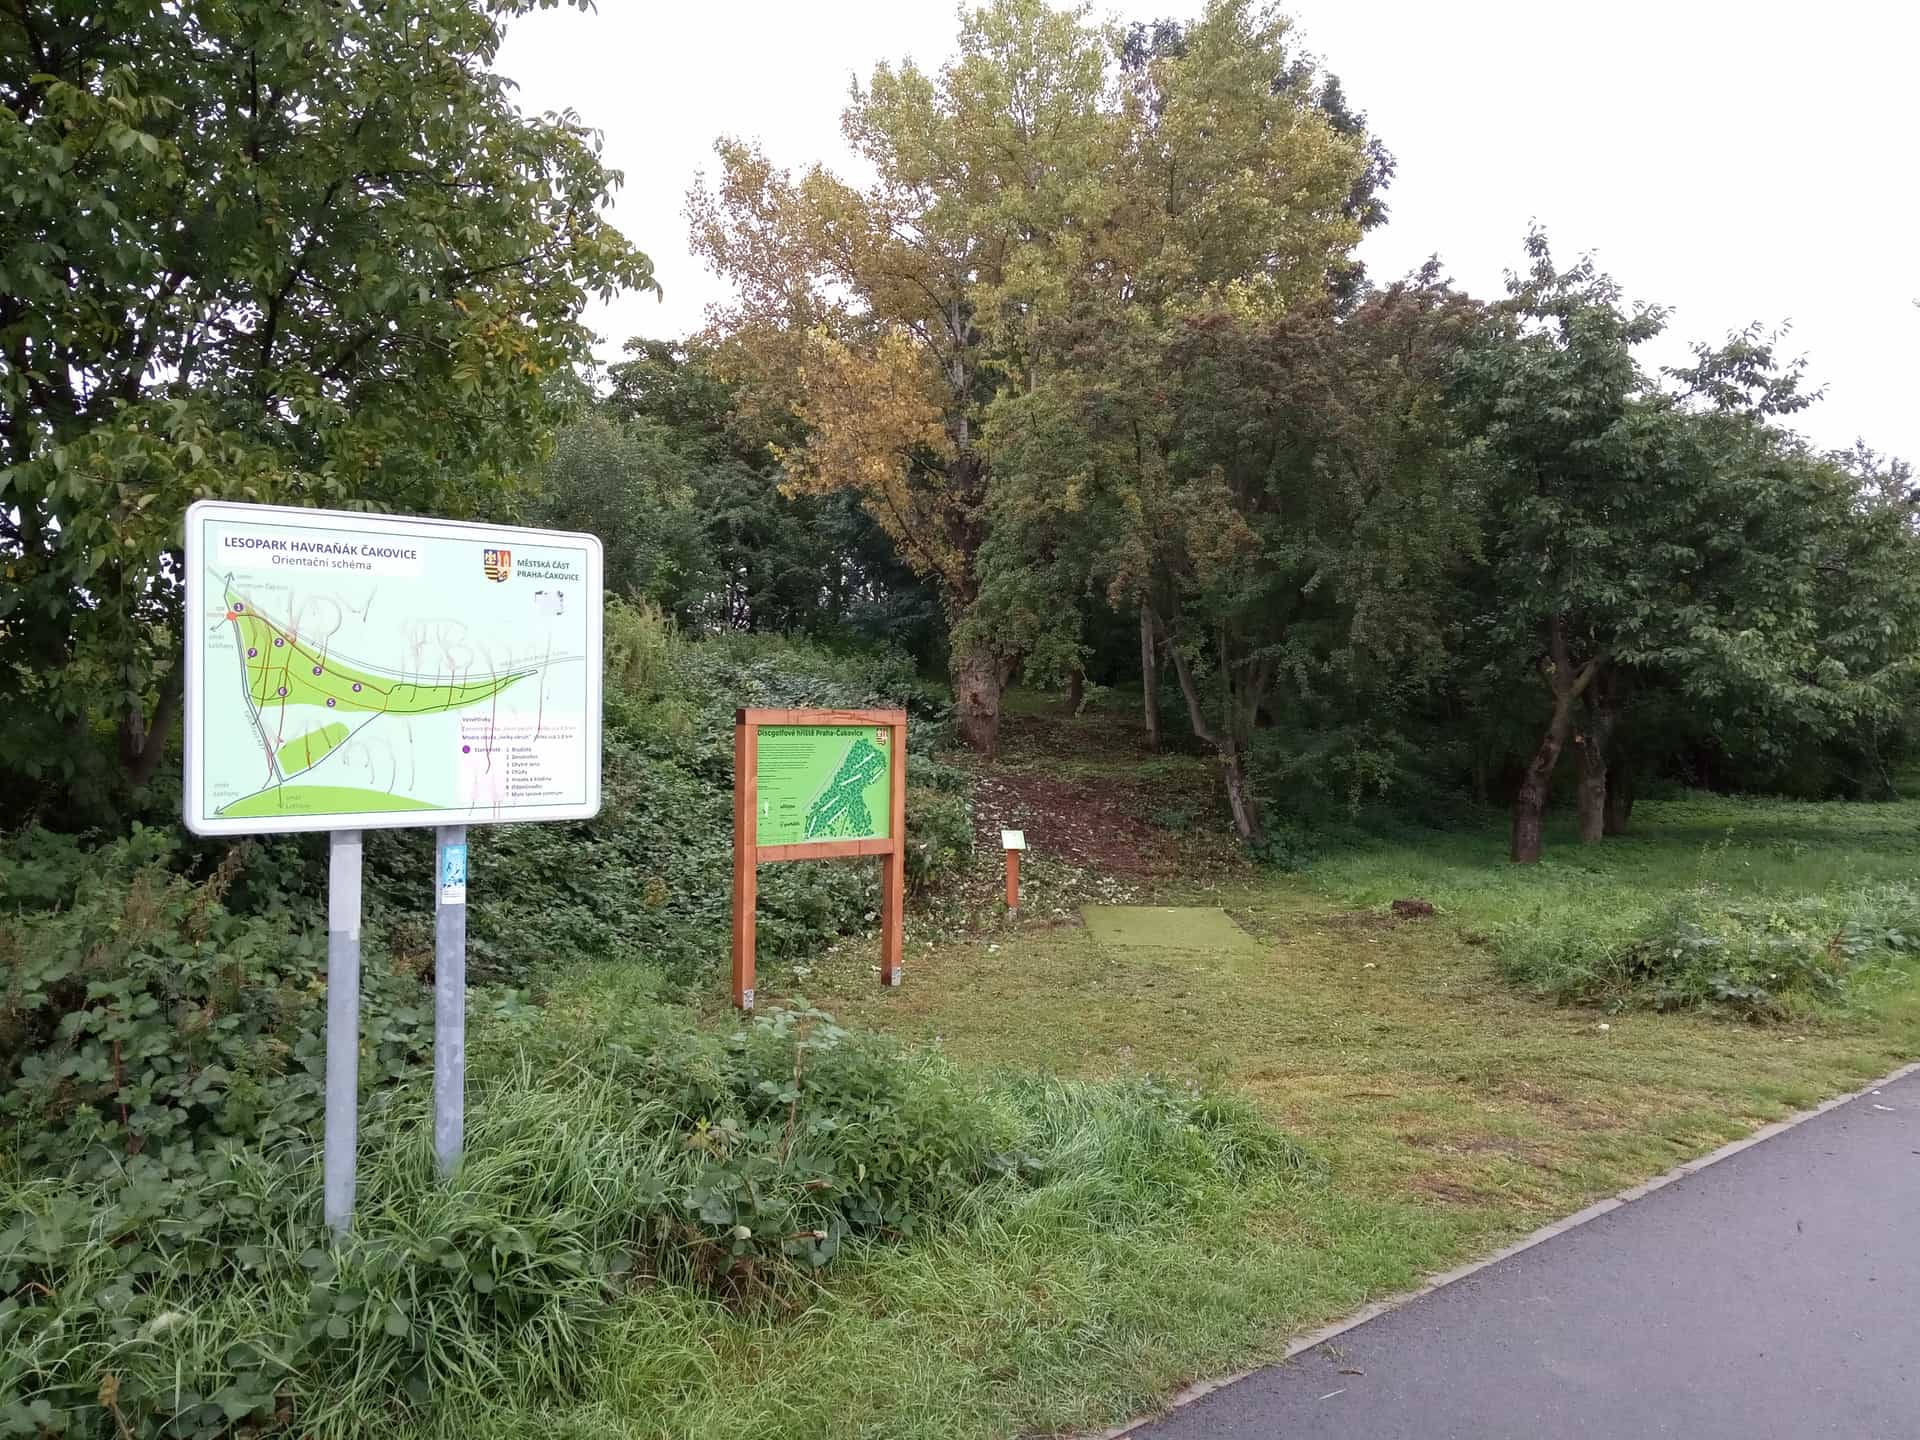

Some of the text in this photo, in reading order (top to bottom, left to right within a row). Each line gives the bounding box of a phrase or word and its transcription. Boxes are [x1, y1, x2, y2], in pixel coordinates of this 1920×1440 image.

[224, 536, 417, 560] LESOPARK HAVRAŇÁK ČAKOVICE
[272, 554, 372, 570] Orientační schéma
[517, 570, 580, 581] PRAHA-ČAKOVICE
